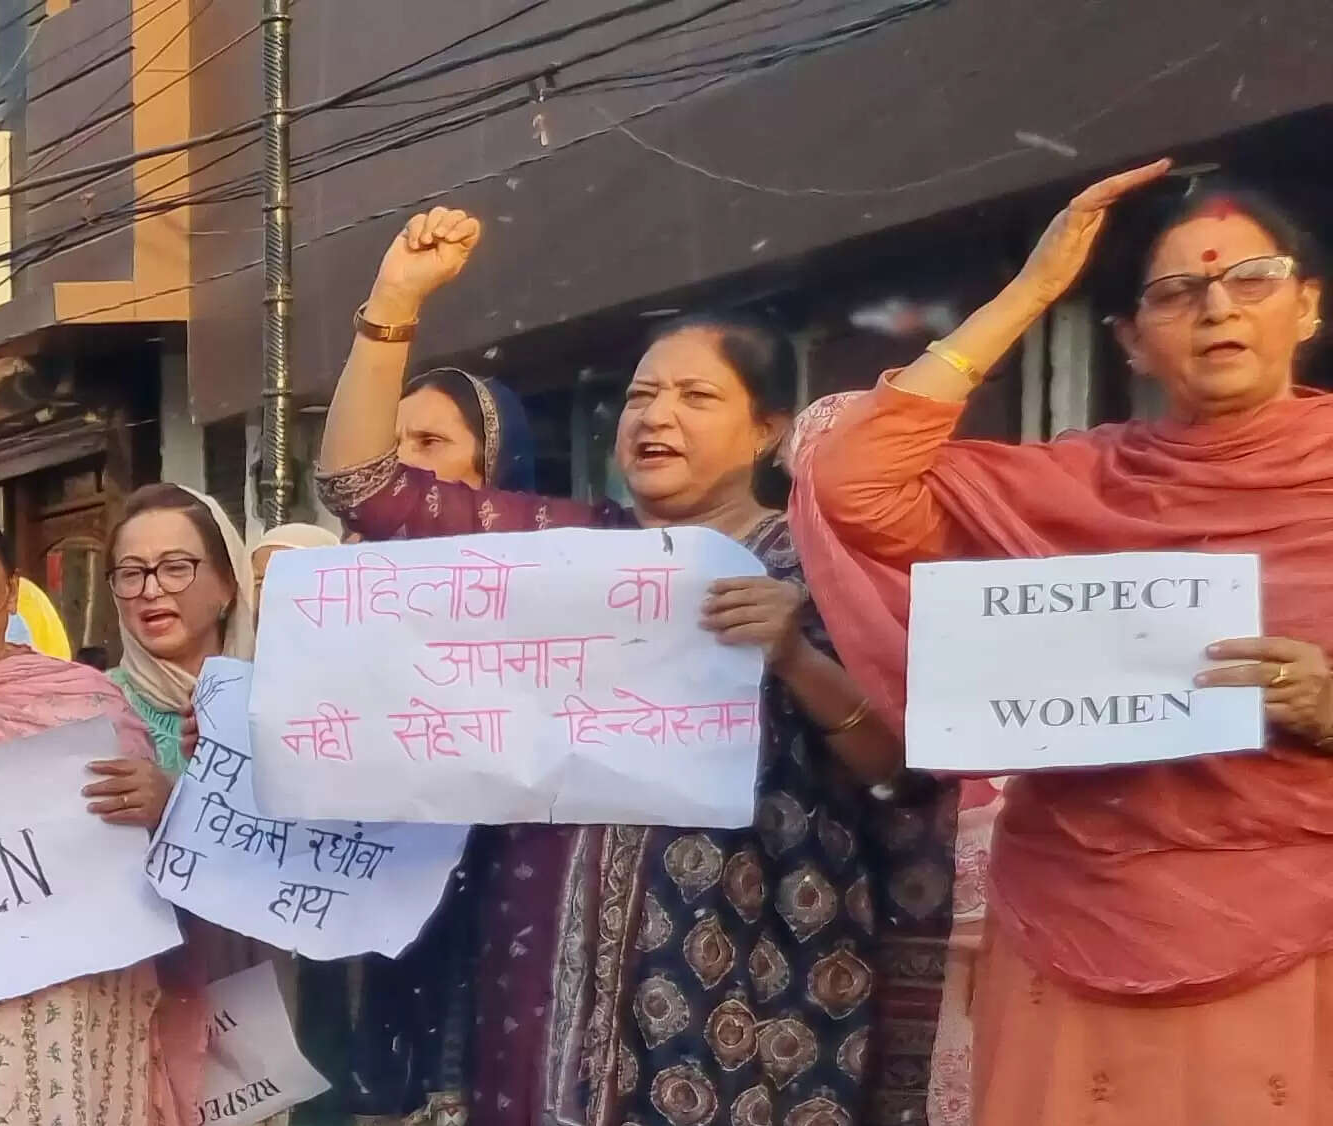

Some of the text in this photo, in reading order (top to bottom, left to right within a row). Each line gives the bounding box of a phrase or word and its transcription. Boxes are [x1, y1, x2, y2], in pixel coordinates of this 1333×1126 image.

[607, 567, 685, 624] का
[981, 577, 1209, 617] RESPECT
[413, 636, 616, 689] अपमान
[281, 702, 360, 760] नहीं
[387, 697, 512, 760] सहेगा
[989, 690, 1196, 728] WOMEN
[194, 792, 297, 869] विक्रम
[269, 881, 349, 929] हाय
[198, 1077, 282, 1126] RESPEC
